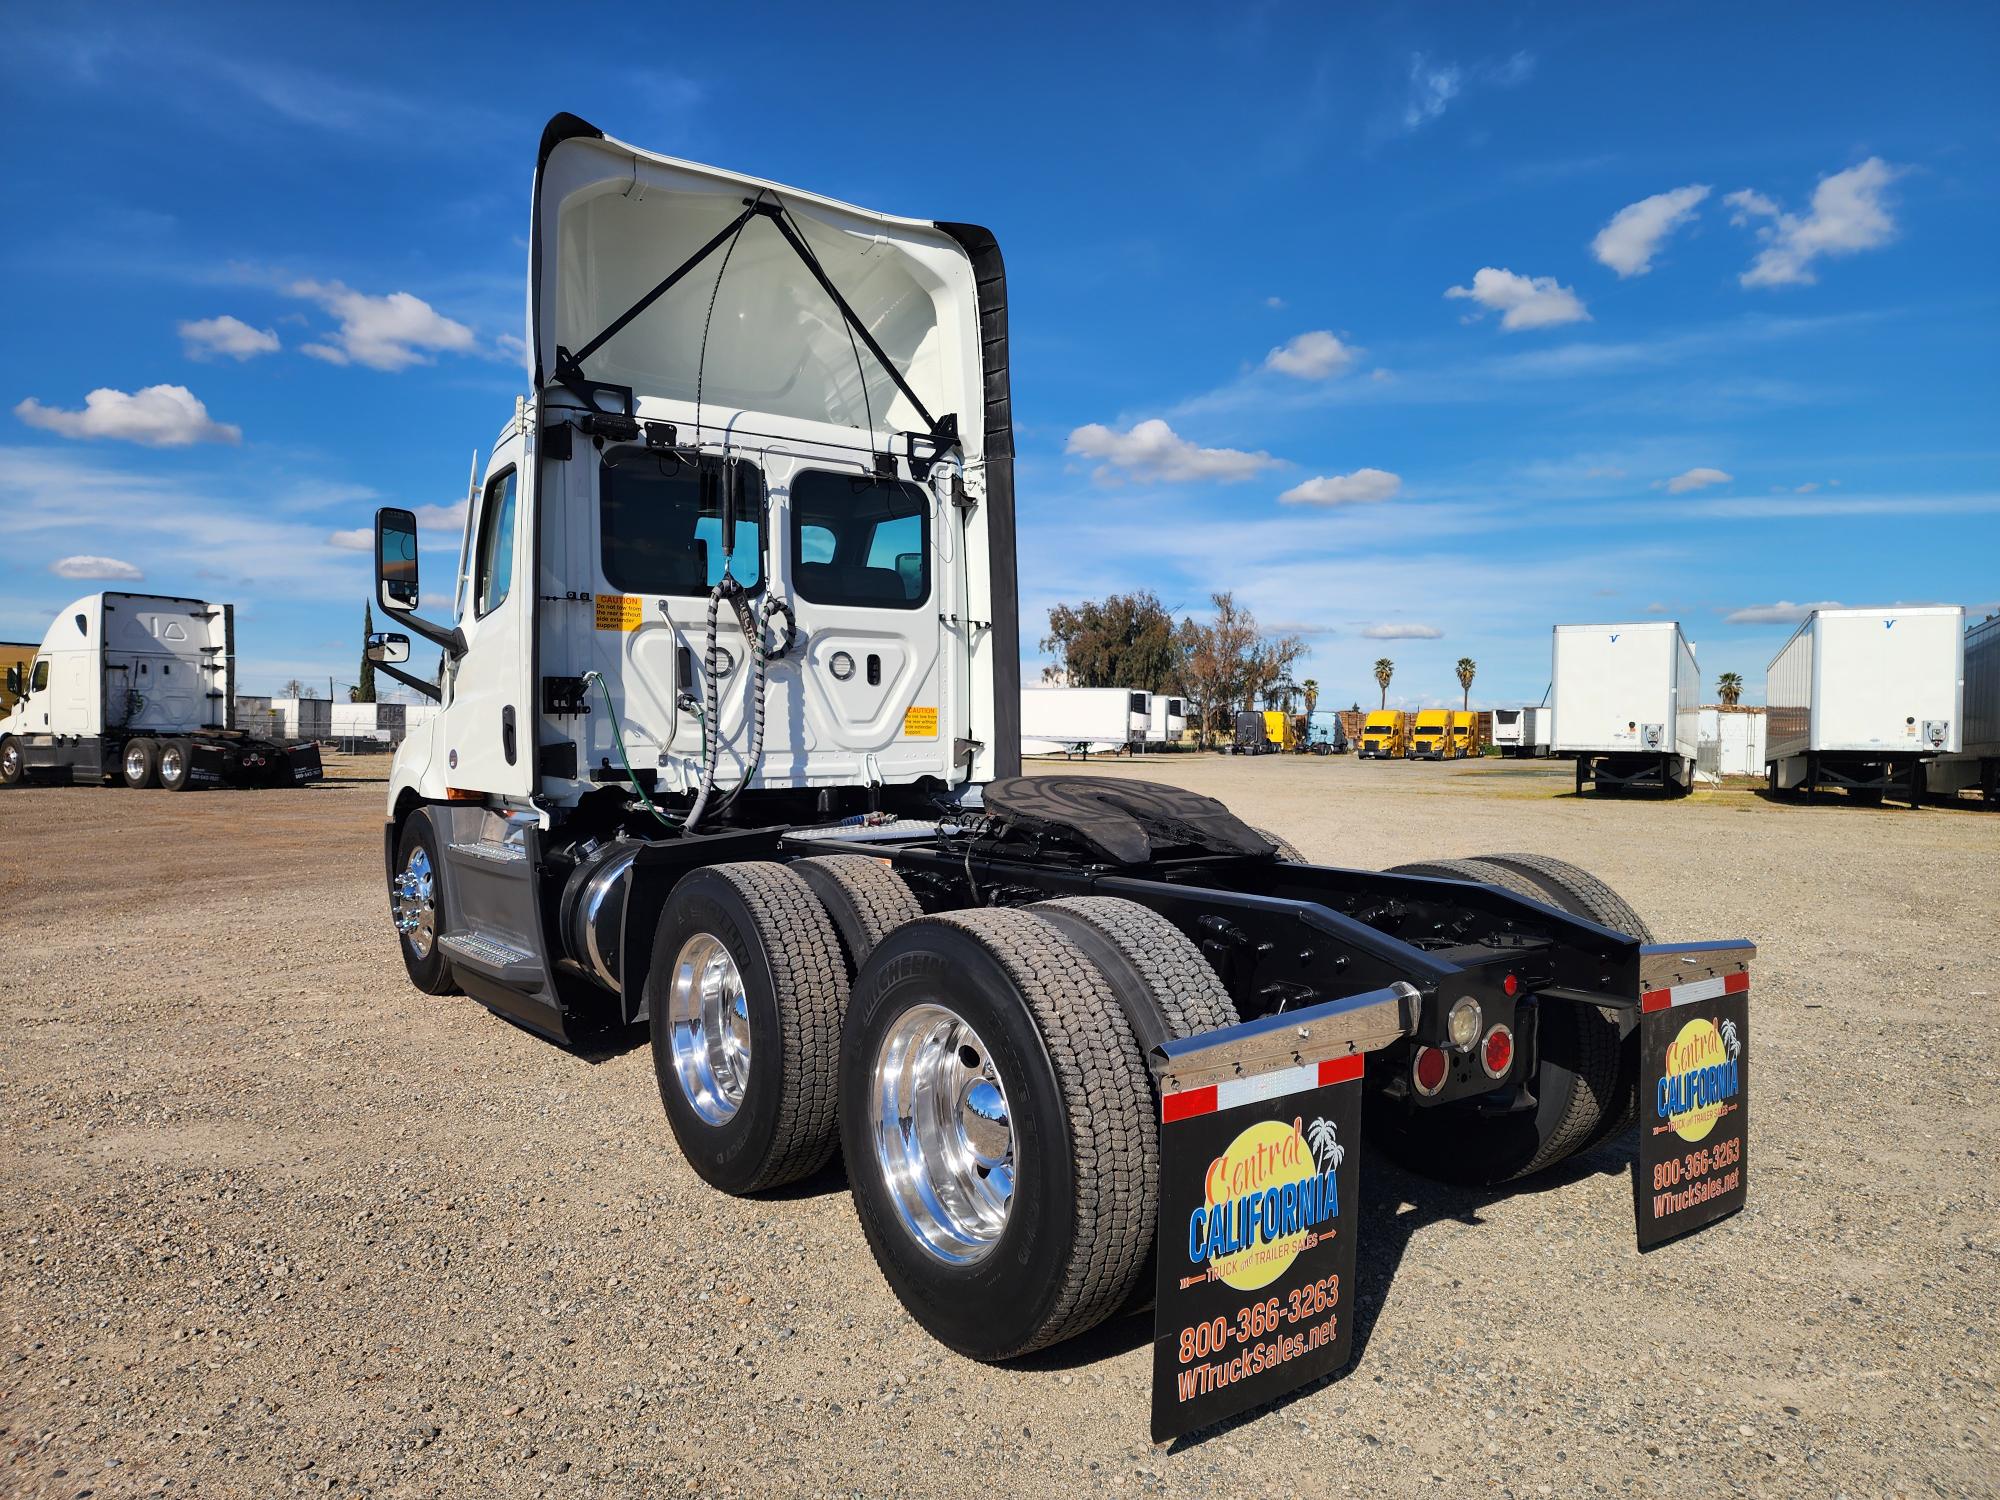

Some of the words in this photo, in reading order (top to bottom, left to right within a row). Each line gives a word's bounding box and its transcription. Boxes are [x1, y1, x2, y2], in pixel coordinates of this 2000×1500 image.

[601, 596, 638, 604] CAUTION
[740, 604, 757, 650] TECTRA
[1666, 1017, 1719, 1078] Central
[1657, 1058, 1739, 1118] CALIFORNIA
[1667, 1118, 1685, 1134] TRUCK
[1694, 1110, 1713, 1126] TRAILER
[1713, 1104, 1728, 1121] SALES
[1205, 1117, 1303, 1206] Central
[1653, 1137, 1740, 1190] 800-366-3263
[1189, 1170, 1340, 1263] CALIFORNIA
[1653, 1167, 1740, 1219] WTruckSales.net
[1206, 1259, 1238, 1283] TRUCK
[1240, 1253, 1253, 1272] and
[1254, 1247, 1290, 1270] TRAILER
[1291, 1232, 1319, 1256] SALES
[1178, 1274, 1340, 1364] 800-366-3263
[1177, 1316, 1338, 1403] WTruckSales.net
